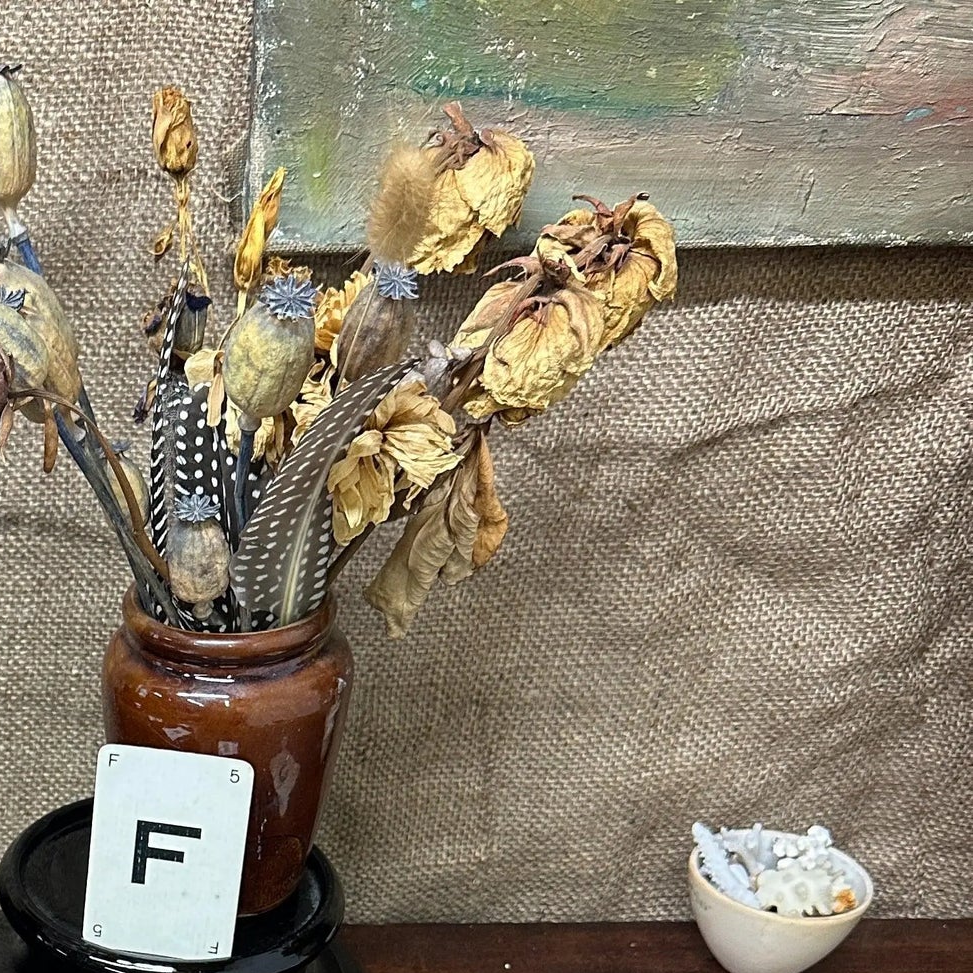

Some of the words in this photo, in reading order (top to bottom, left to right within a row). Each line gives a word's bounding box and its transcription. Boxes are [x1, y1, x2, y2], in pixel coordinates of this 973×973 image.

[108, 753, 120, 767] F
[229, 769, 240, 784] 5
[130, 819, 203, 885] F
[92, 923, 103, 938] 5
[207, 941, 219, 955] F
